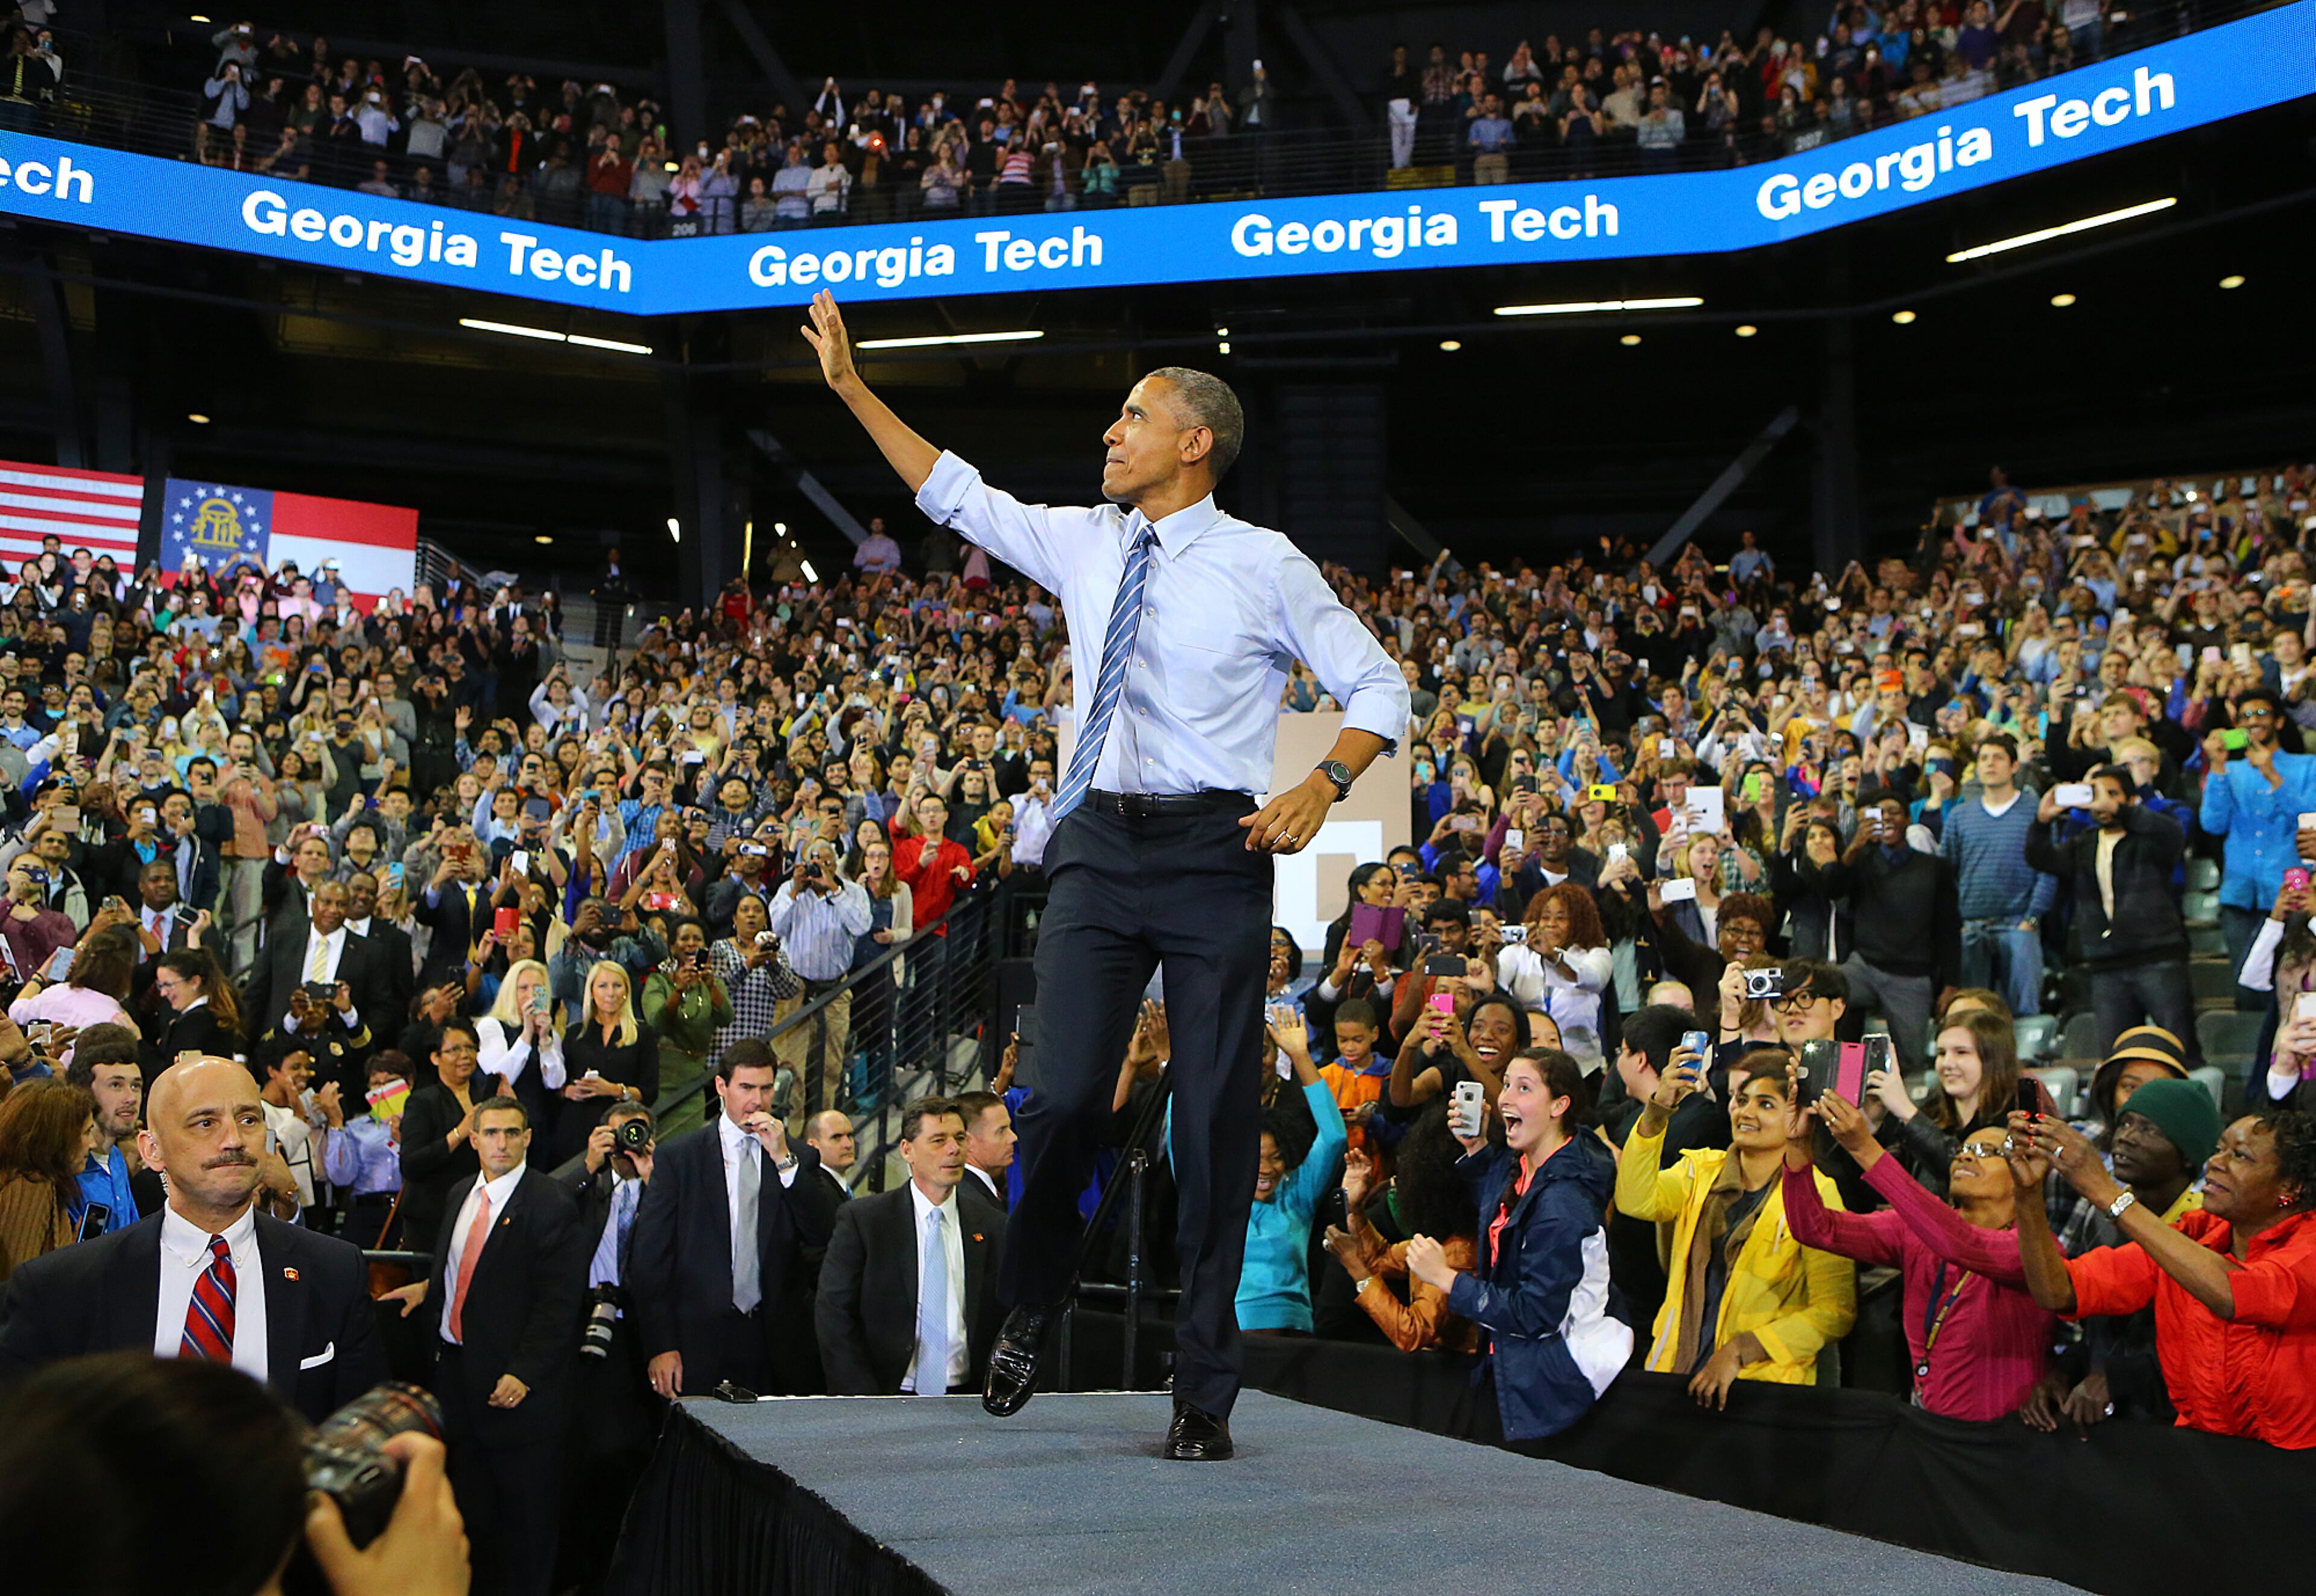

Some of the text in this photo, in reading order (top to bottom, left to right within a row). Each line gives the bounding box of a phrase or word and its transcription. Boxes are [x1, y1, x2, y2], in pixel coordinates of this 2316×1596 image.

[1756, 66, 2175, 220] Georgia Tech
[242, 190, 631, 292] Georgia Tech
[748, 226, 1103, 288] Georgia Tech
[1231, 194, 1619, 258] Georgia Tech
